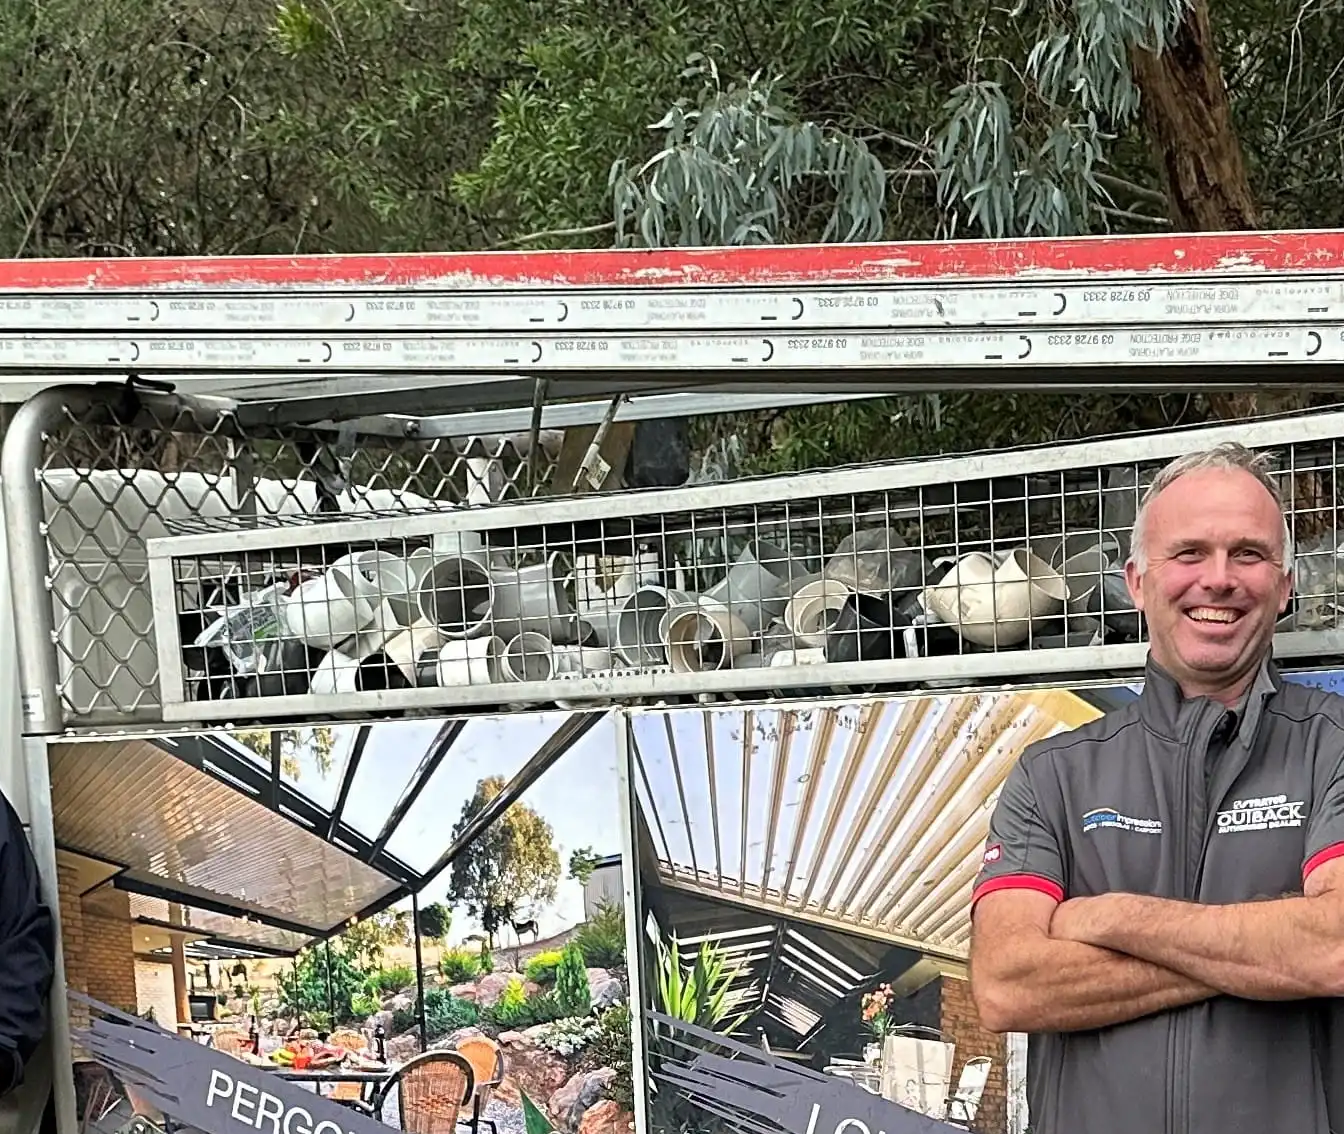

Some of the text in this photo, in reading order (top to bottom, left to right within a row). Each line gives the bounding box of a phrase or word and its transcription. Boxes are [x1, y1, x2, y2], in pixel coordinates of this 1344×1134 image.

[1084, 291, 1150, 302] 03 9728 2333
[835, 339, 846, 348] 03
[1048, 335, 1114, 345] 03 9728 2333
[1217, 805, 1306, 827] OUTBACK
